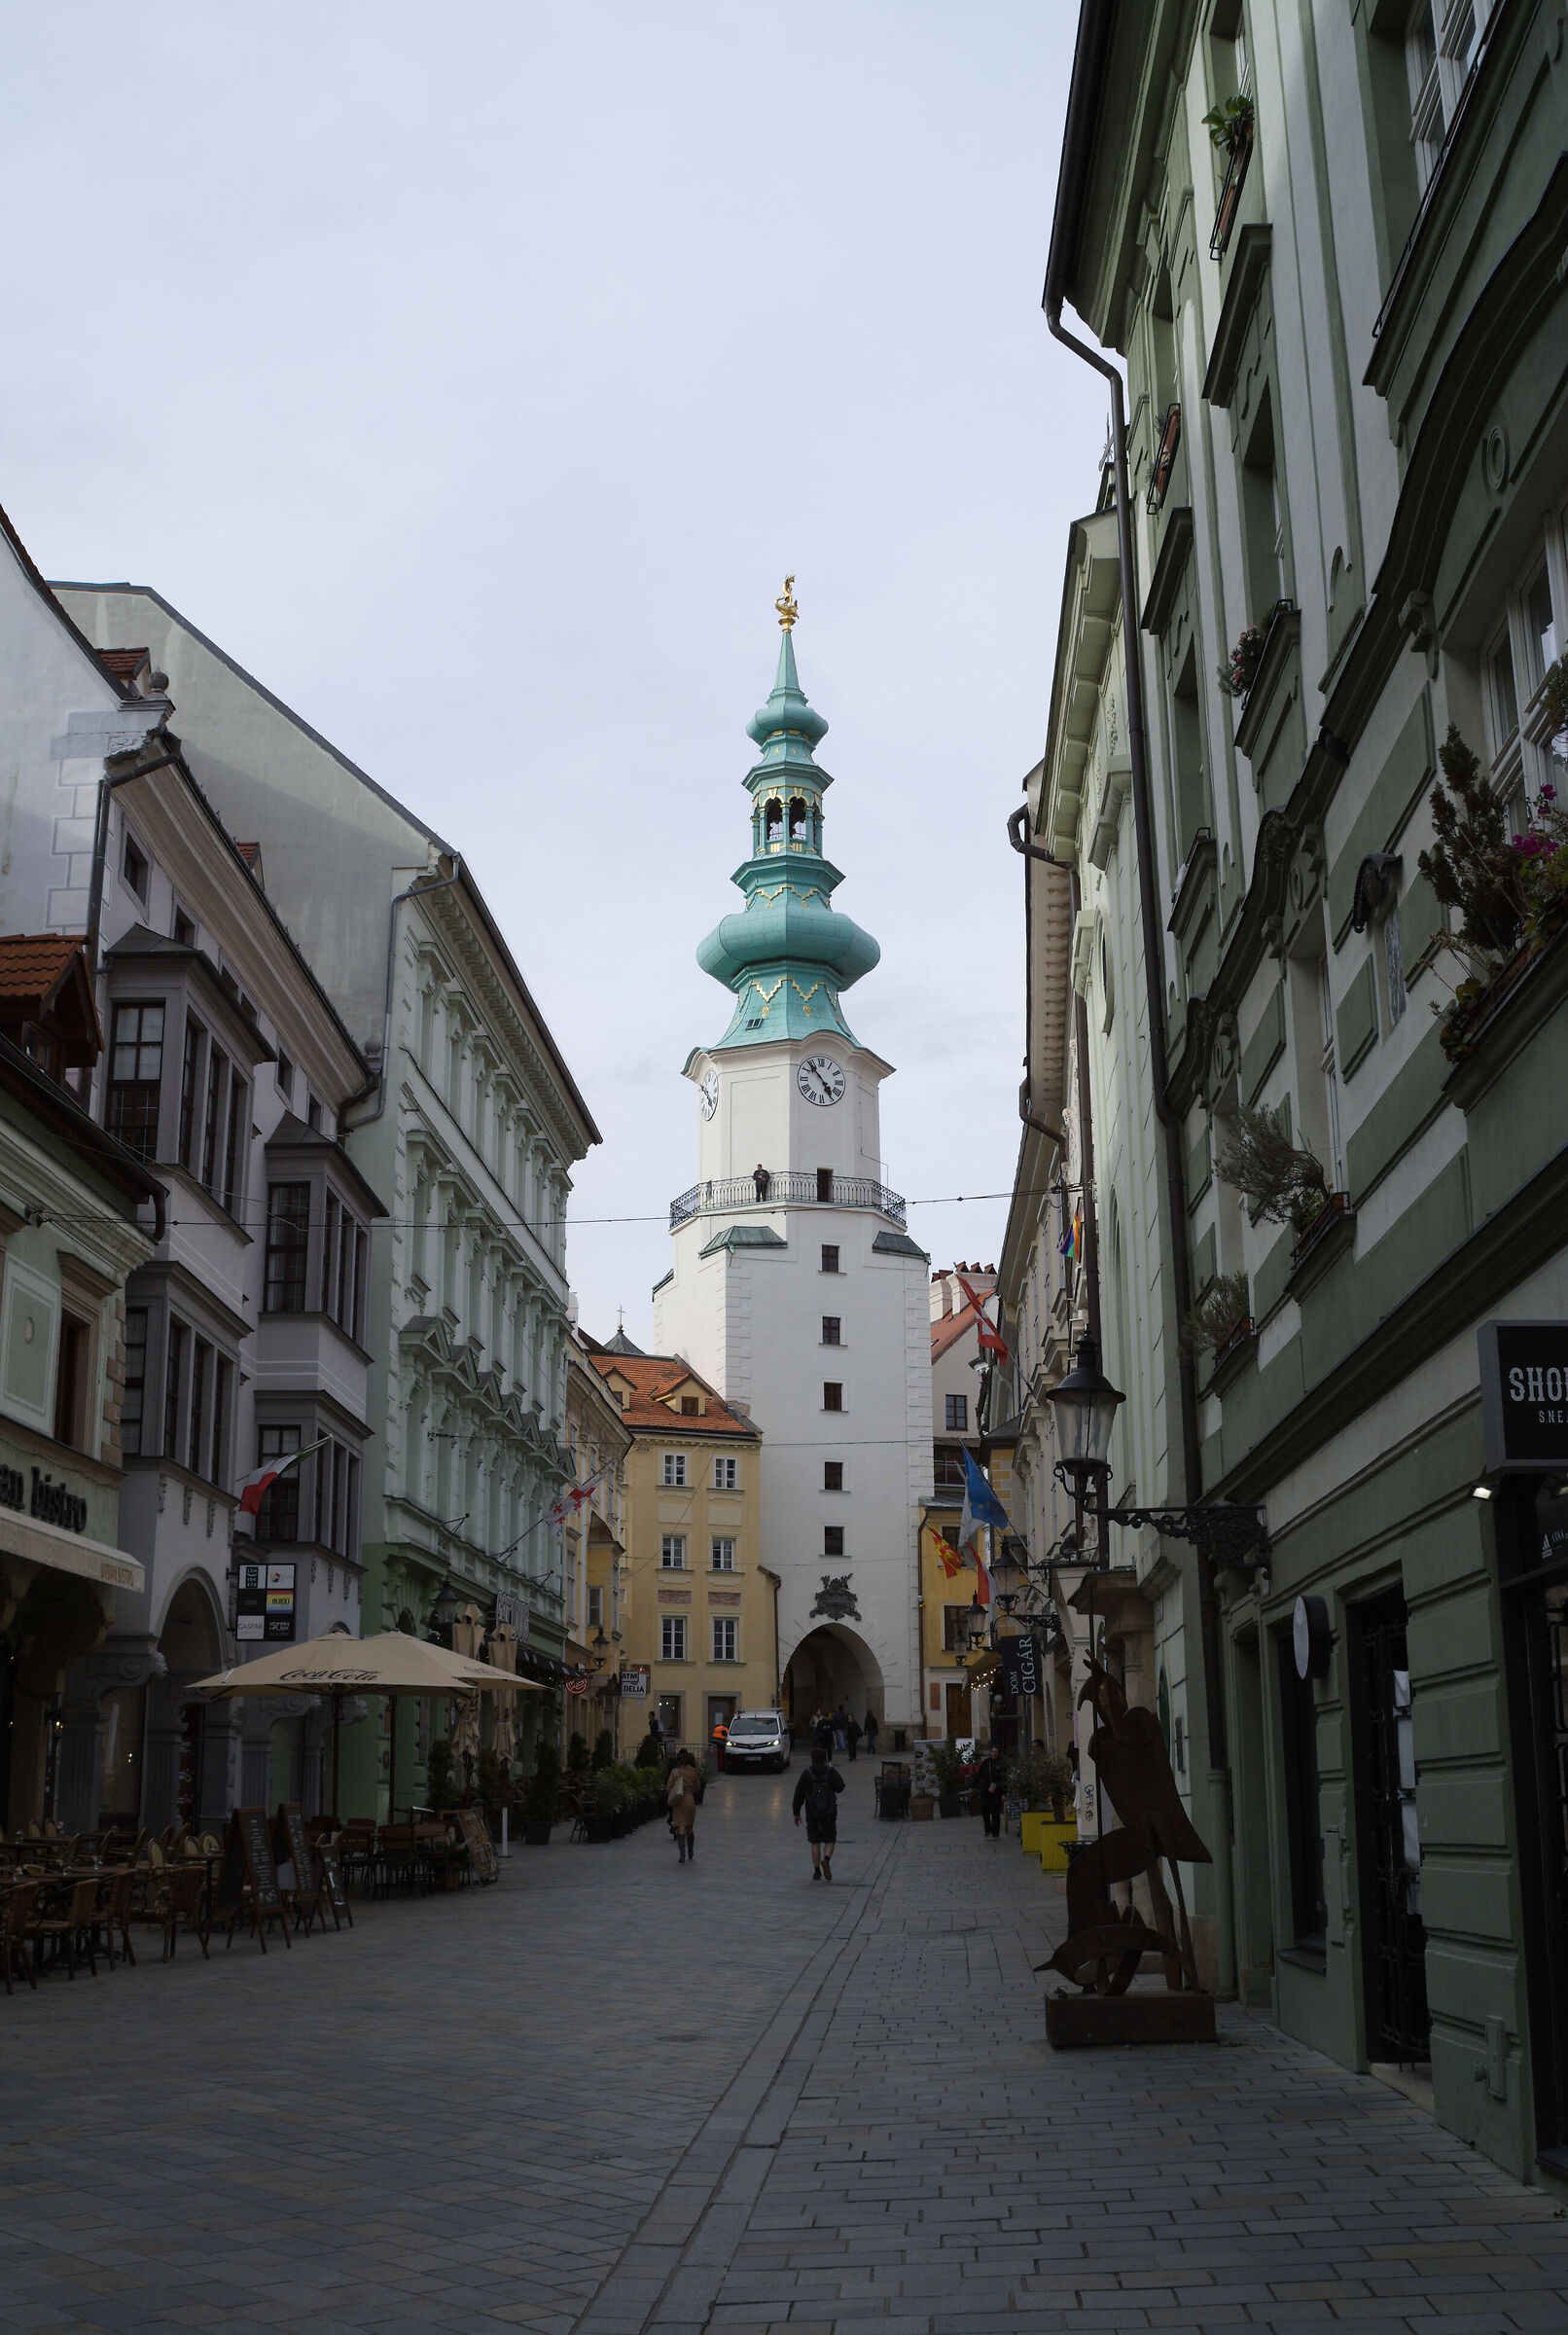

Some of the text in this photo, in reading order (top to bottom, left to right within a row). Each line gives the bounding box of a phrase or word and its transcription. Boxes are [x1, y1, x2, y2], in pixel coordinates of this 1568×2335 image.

[1538, 1410, 1568, 1423] SNE
[30, 1466, 88, 1532] bistro
[1010, 1670, 1019, 1695] DOM
[1016, 1635, 1037, 1694] CIGÁR
